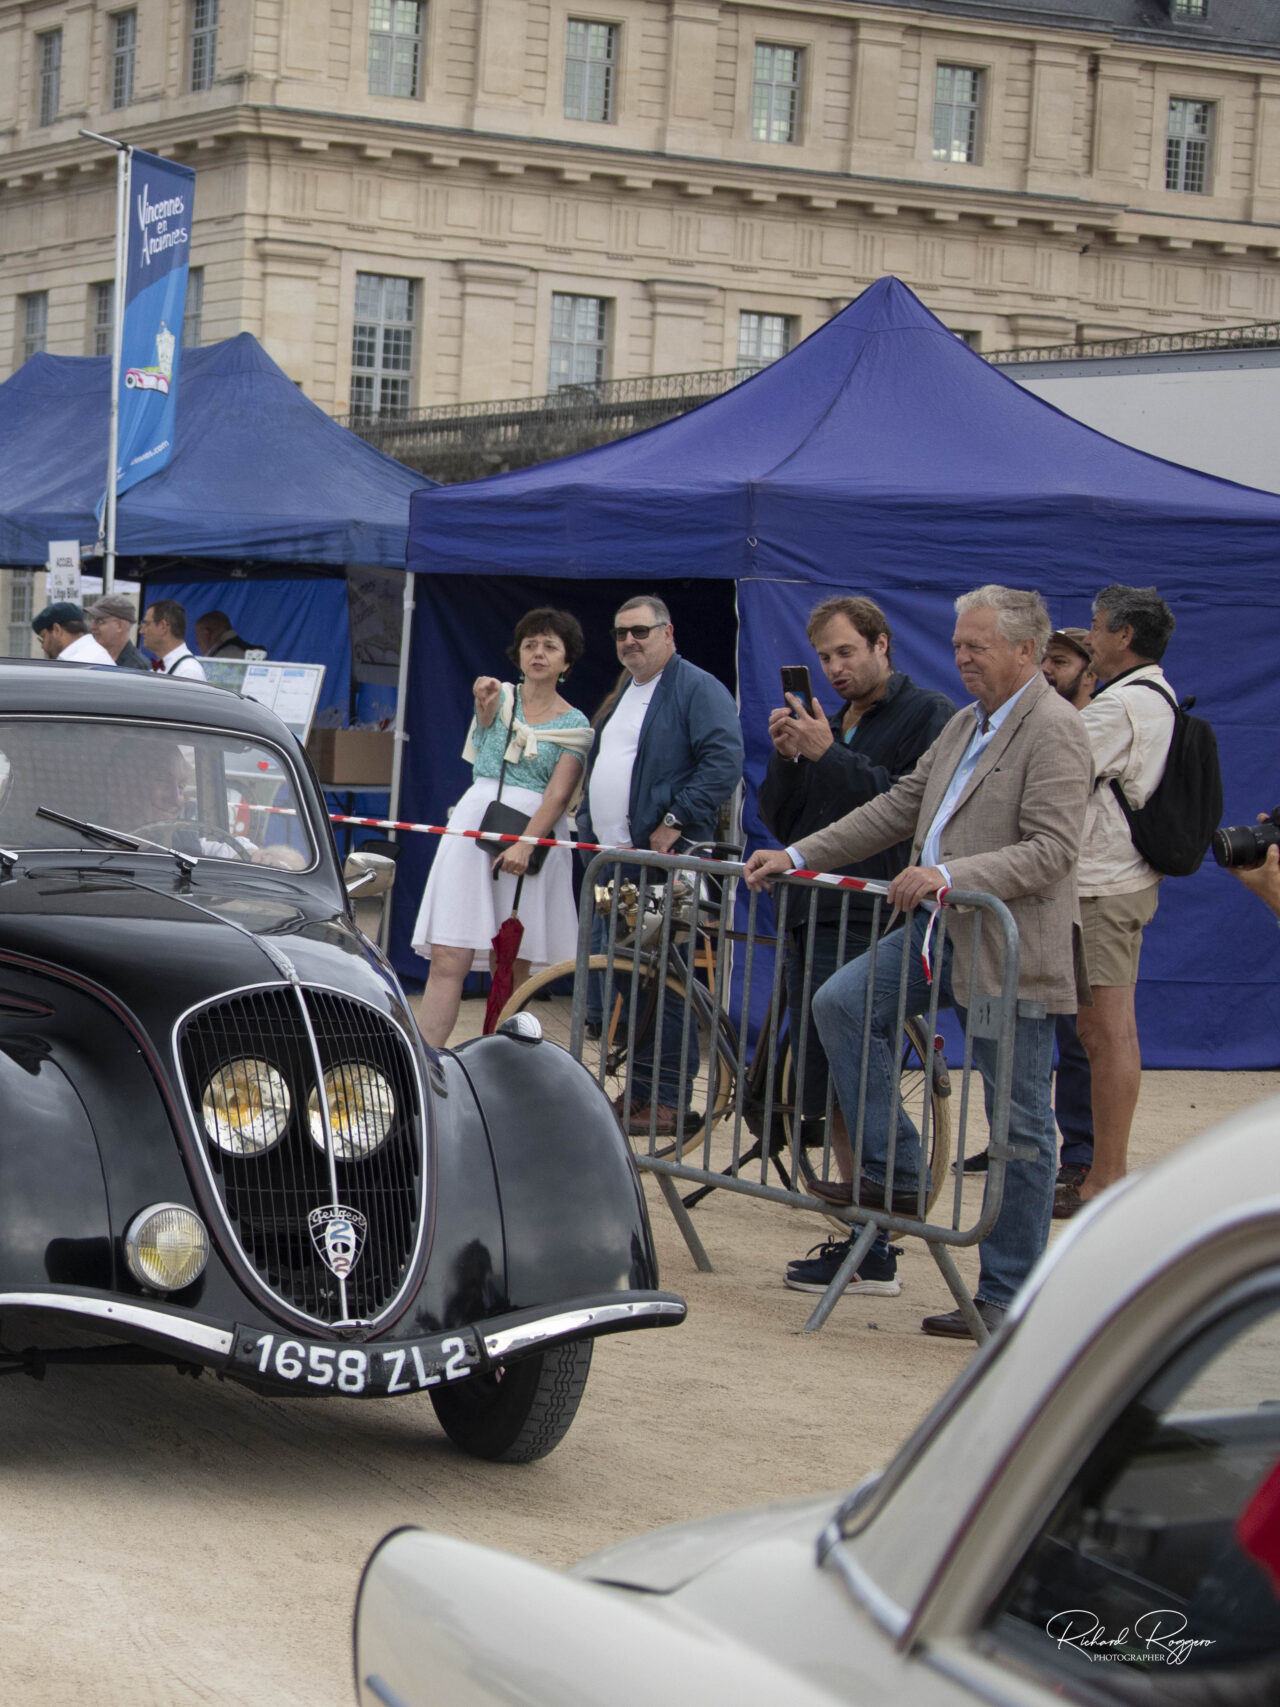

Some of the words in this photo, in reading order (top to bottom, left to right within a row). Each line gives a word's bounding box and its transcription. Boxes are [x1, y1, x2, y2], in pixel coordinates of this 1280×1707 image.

[137, 183, 185, 231] Vincennes
[157, 220, 168, 234] en
[140, 227, 189, 268] Anciennes
[56, 557, 75, 569] ACCUEIL
[311, 1208, 367, 1226] Peugeot
[256, 1335, 368, 1393] 1658
[383, 1337, 471, 1393] ZL2
